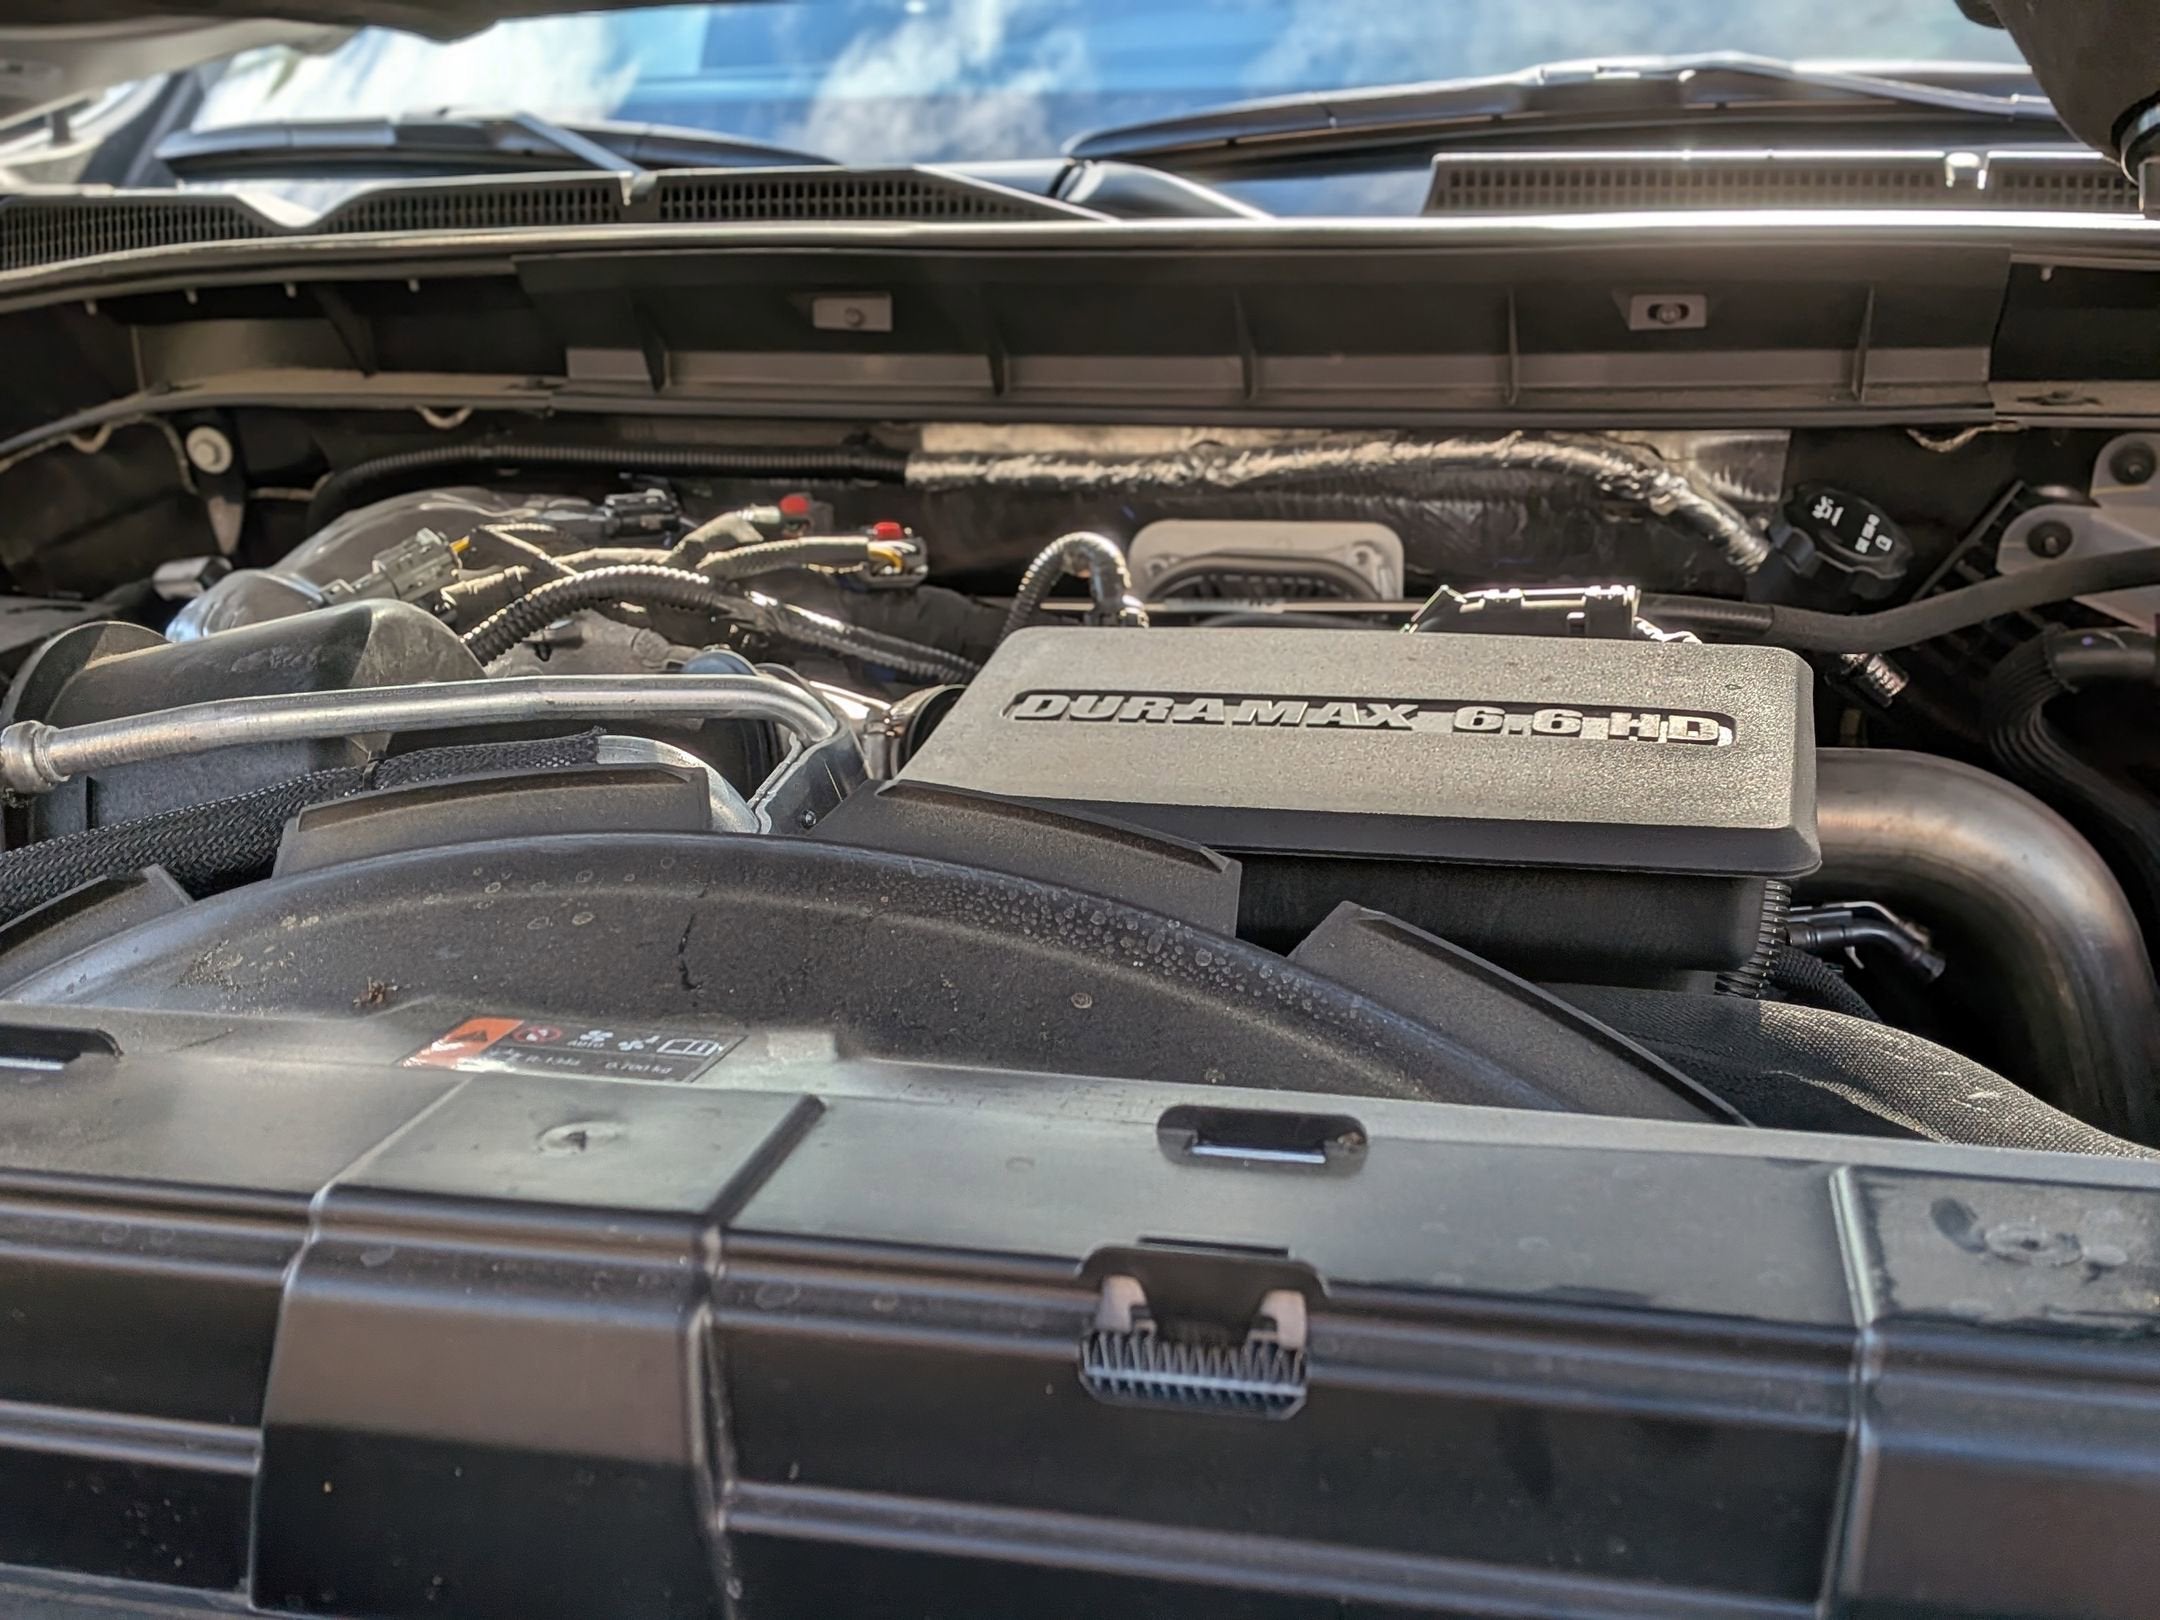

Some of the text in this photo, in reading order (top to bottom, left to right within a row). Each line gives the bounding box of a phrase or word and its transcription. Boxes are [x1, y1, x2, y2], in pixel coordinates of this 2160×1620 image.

[1013, 694, 1719, 745] DURAMAX 6.6 HD
